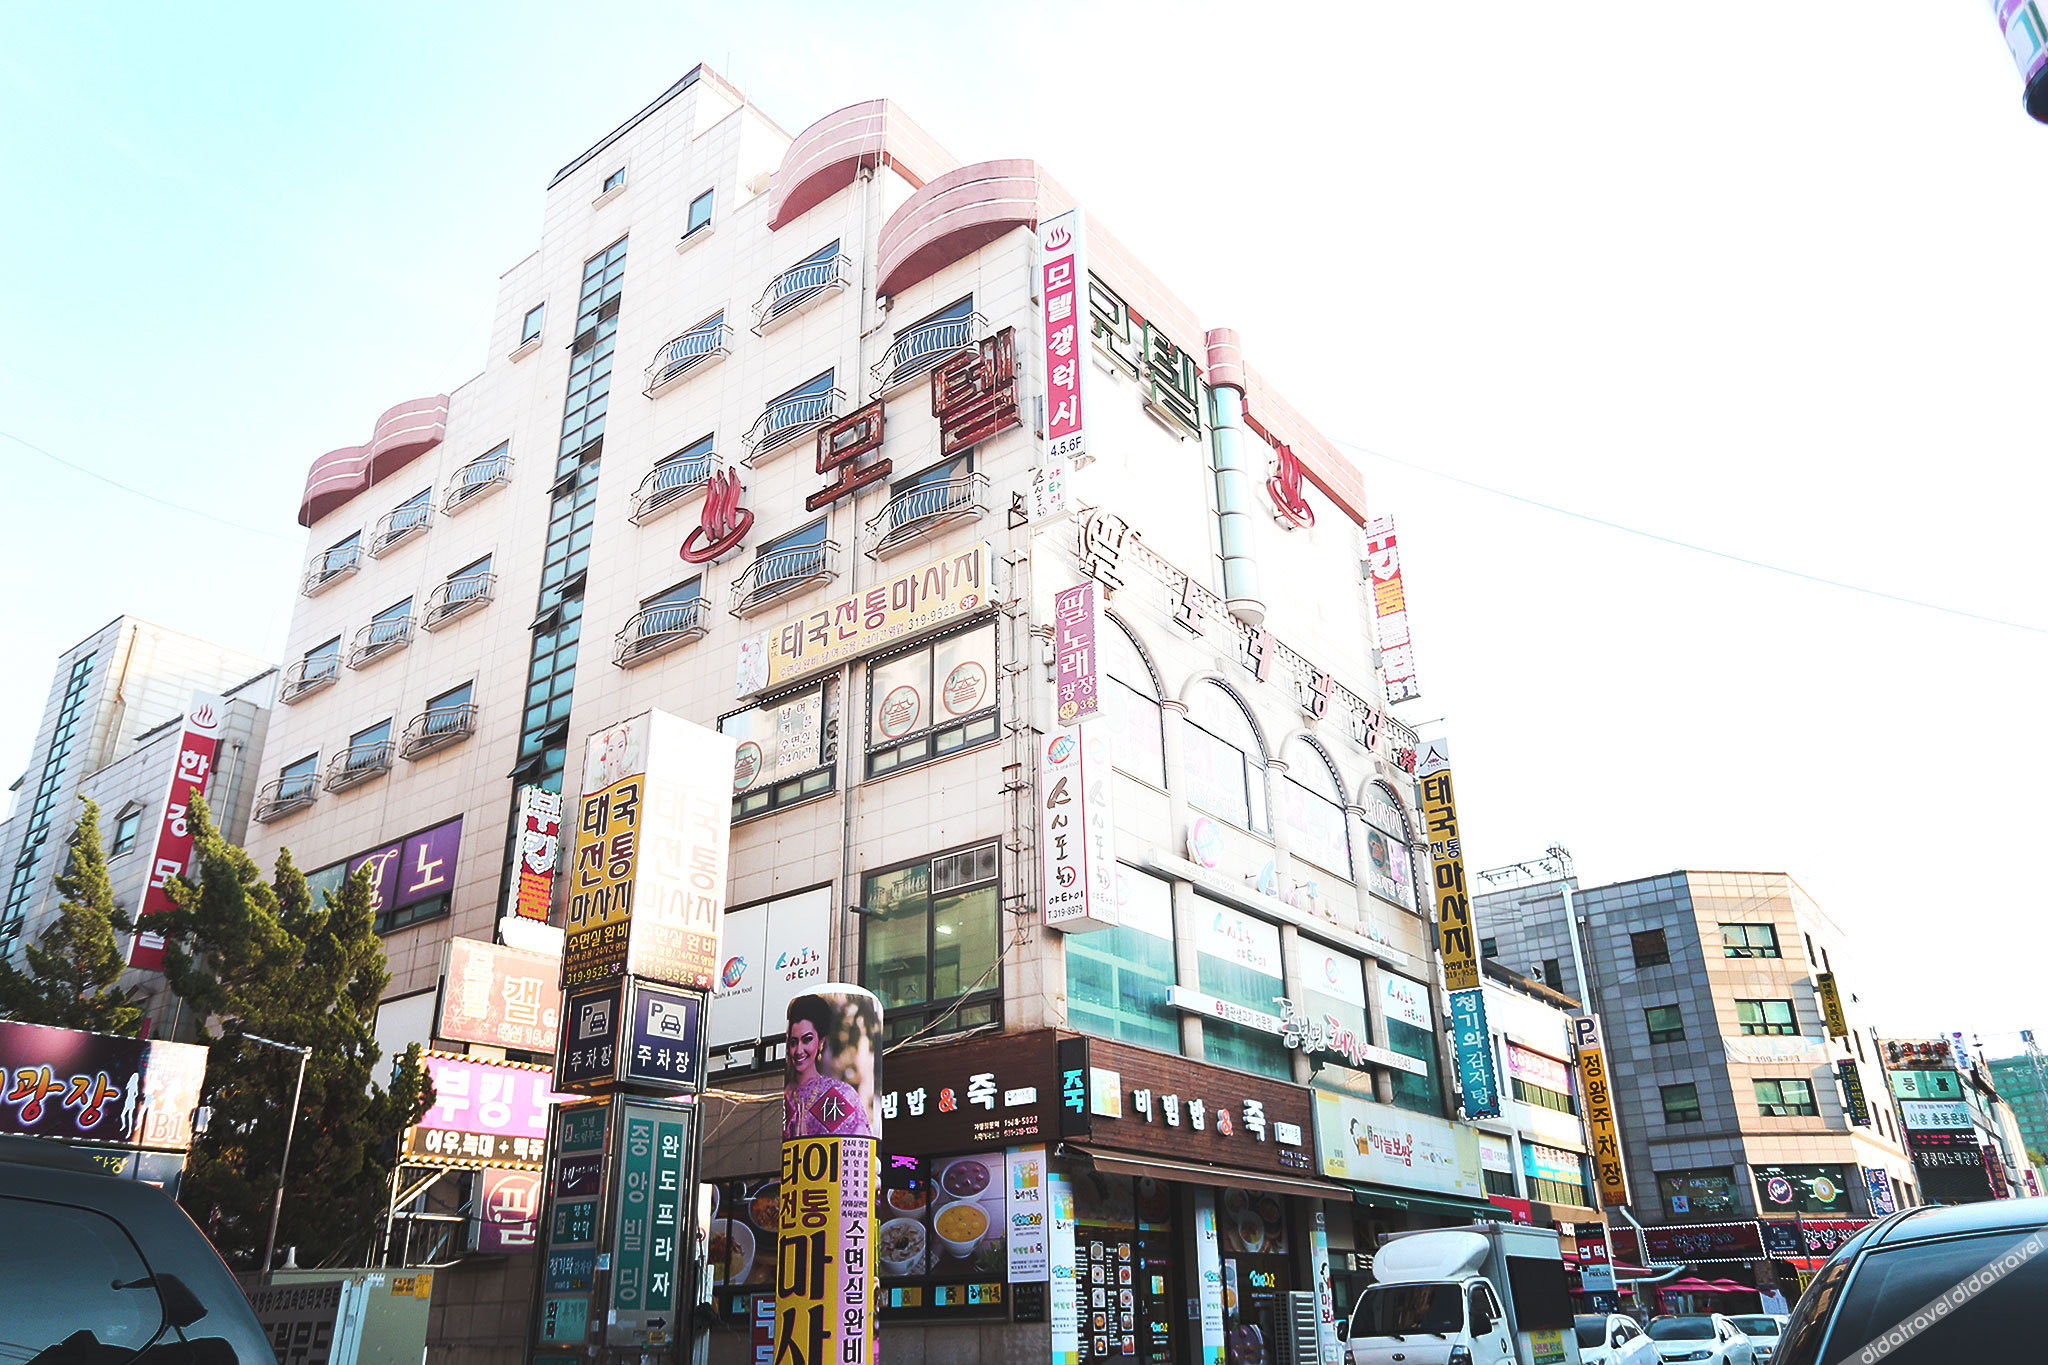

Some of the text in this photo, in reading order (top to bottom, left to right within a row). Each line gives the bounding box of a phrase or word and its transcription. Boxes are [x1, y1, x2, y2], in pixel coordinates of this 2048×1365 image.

[582, 781, 642, 839] 태국
[1424, 776, 1458, 836] 태국
[578, 830, 635, 889] 전통
[1429, 837, 1460, 862] 전통
[570, 878, 634, 929] 마사지
[582, 1005, 594, 1022] P
[651, 1002, 664, 1017] P
[1575, 1017, 1597, 1046] P
[570, 1043, 612, 1072] 주차장
[636, 1043, 690, 1074] 주차장
[1466, 1050, 1492, 1106] 감자탕
[938, 1087, 957, 1113] &
[966, 1072, 998, 1111] 죽
[1130, 1088, 1267, 1142] 비빔밥 & 죽
[150, 1110, 184, 1144] B1
[1583, 1053, 1622, 1187] 정왕주차장
[619, 1124, 651, 1302] 중앙빌딩
[651, 1134, 680, 1298] 완도프라자
[780, 1188, 831, 1230] 전통
